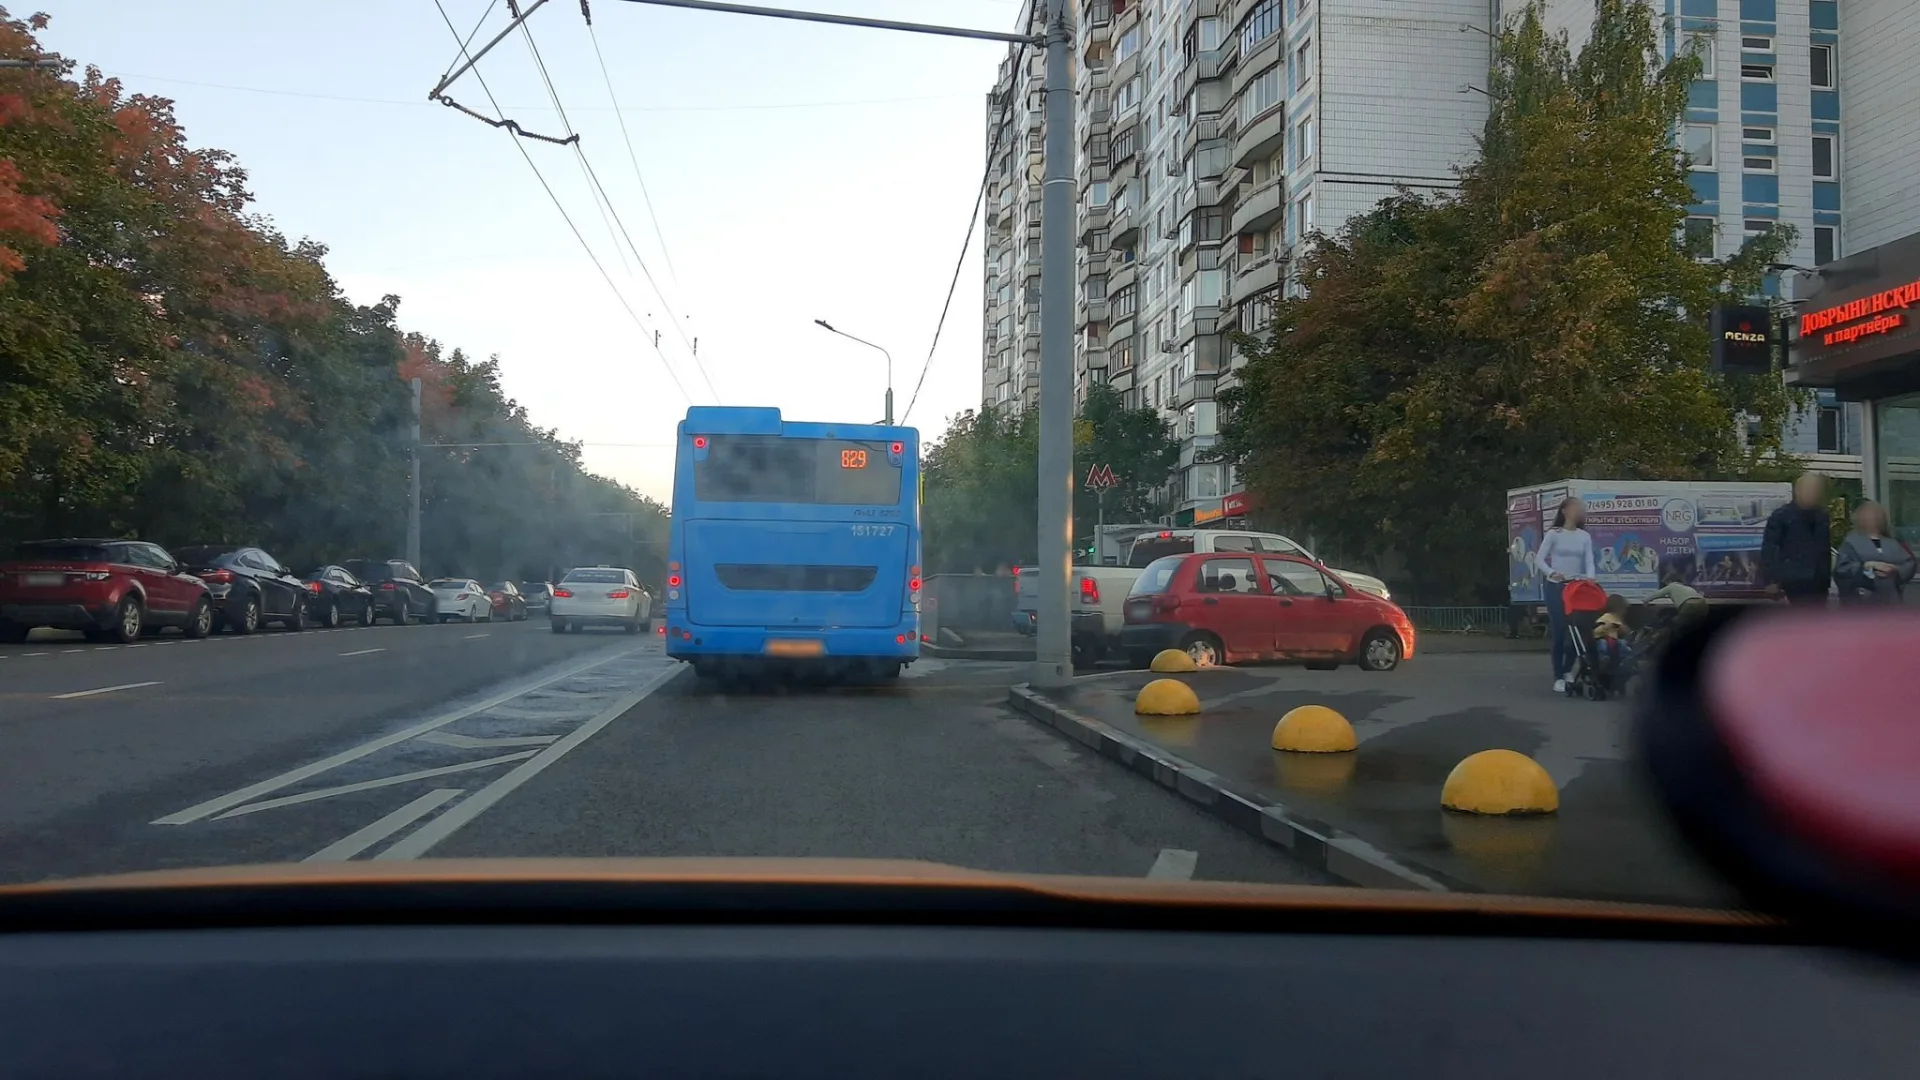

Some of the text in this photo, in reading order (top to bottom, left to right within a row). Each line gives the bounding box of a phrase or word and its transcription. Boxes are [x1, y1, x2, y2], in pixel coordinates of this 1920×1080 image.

[1824, 313, 1901, 346] и партнёры
[1724, 331, 1765, 342] MENZA
[841, 449, 867, 468] 829
[1617, 500, 1632, 508] 928
[1635, 499, 1645, 508] 01
[1647, 499, 1659, 507] 80
[1585, 516, 1615, 524] ТКРЫТИЕ
[1665, 510, 1692, 521] NRG
[852, 524, 894, 537] 151727
[1660, 537, 1690, 545] НАБОР
[1667, 545, 1695, 554] ДЕТЕЙ
